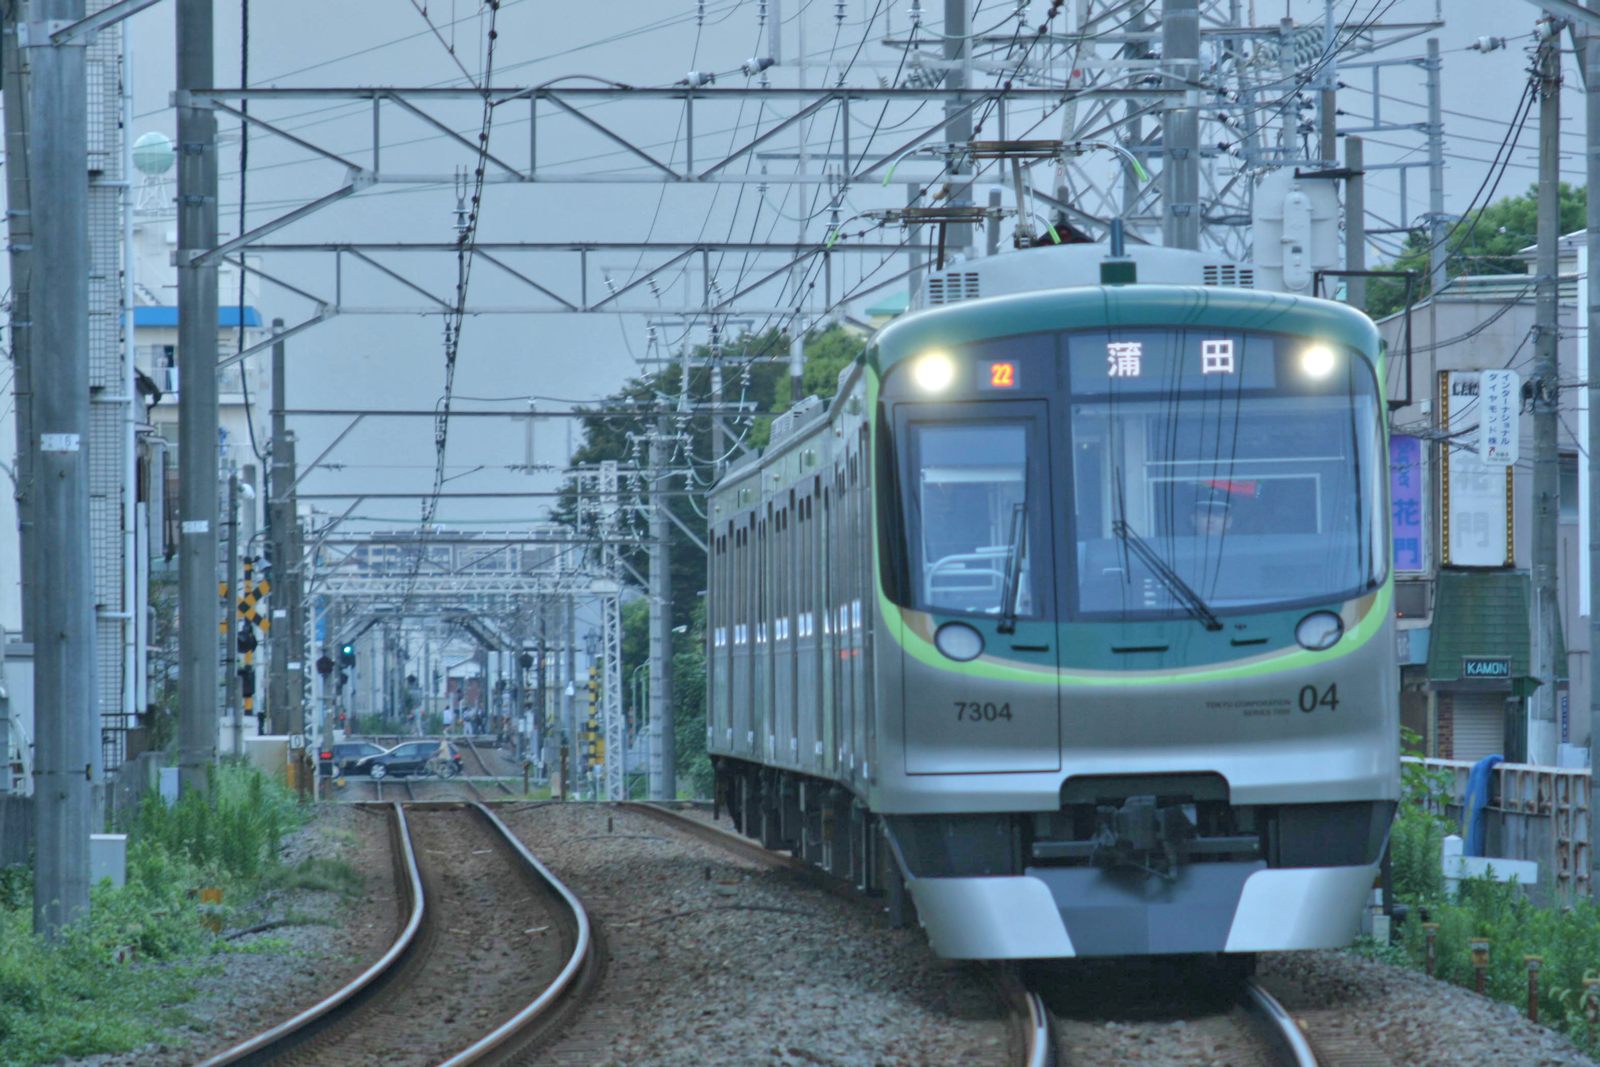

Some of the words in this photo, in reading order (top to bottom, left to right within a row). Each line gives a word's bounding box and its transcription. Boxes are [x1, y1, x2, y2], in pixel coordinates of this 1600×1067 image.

[991, 363, 1014, 387] 22
[1467, 661, 1508, 675] KAMON
[1299, 683, 1339, 713] 04
[954, 702, 1012, 722] 7304
